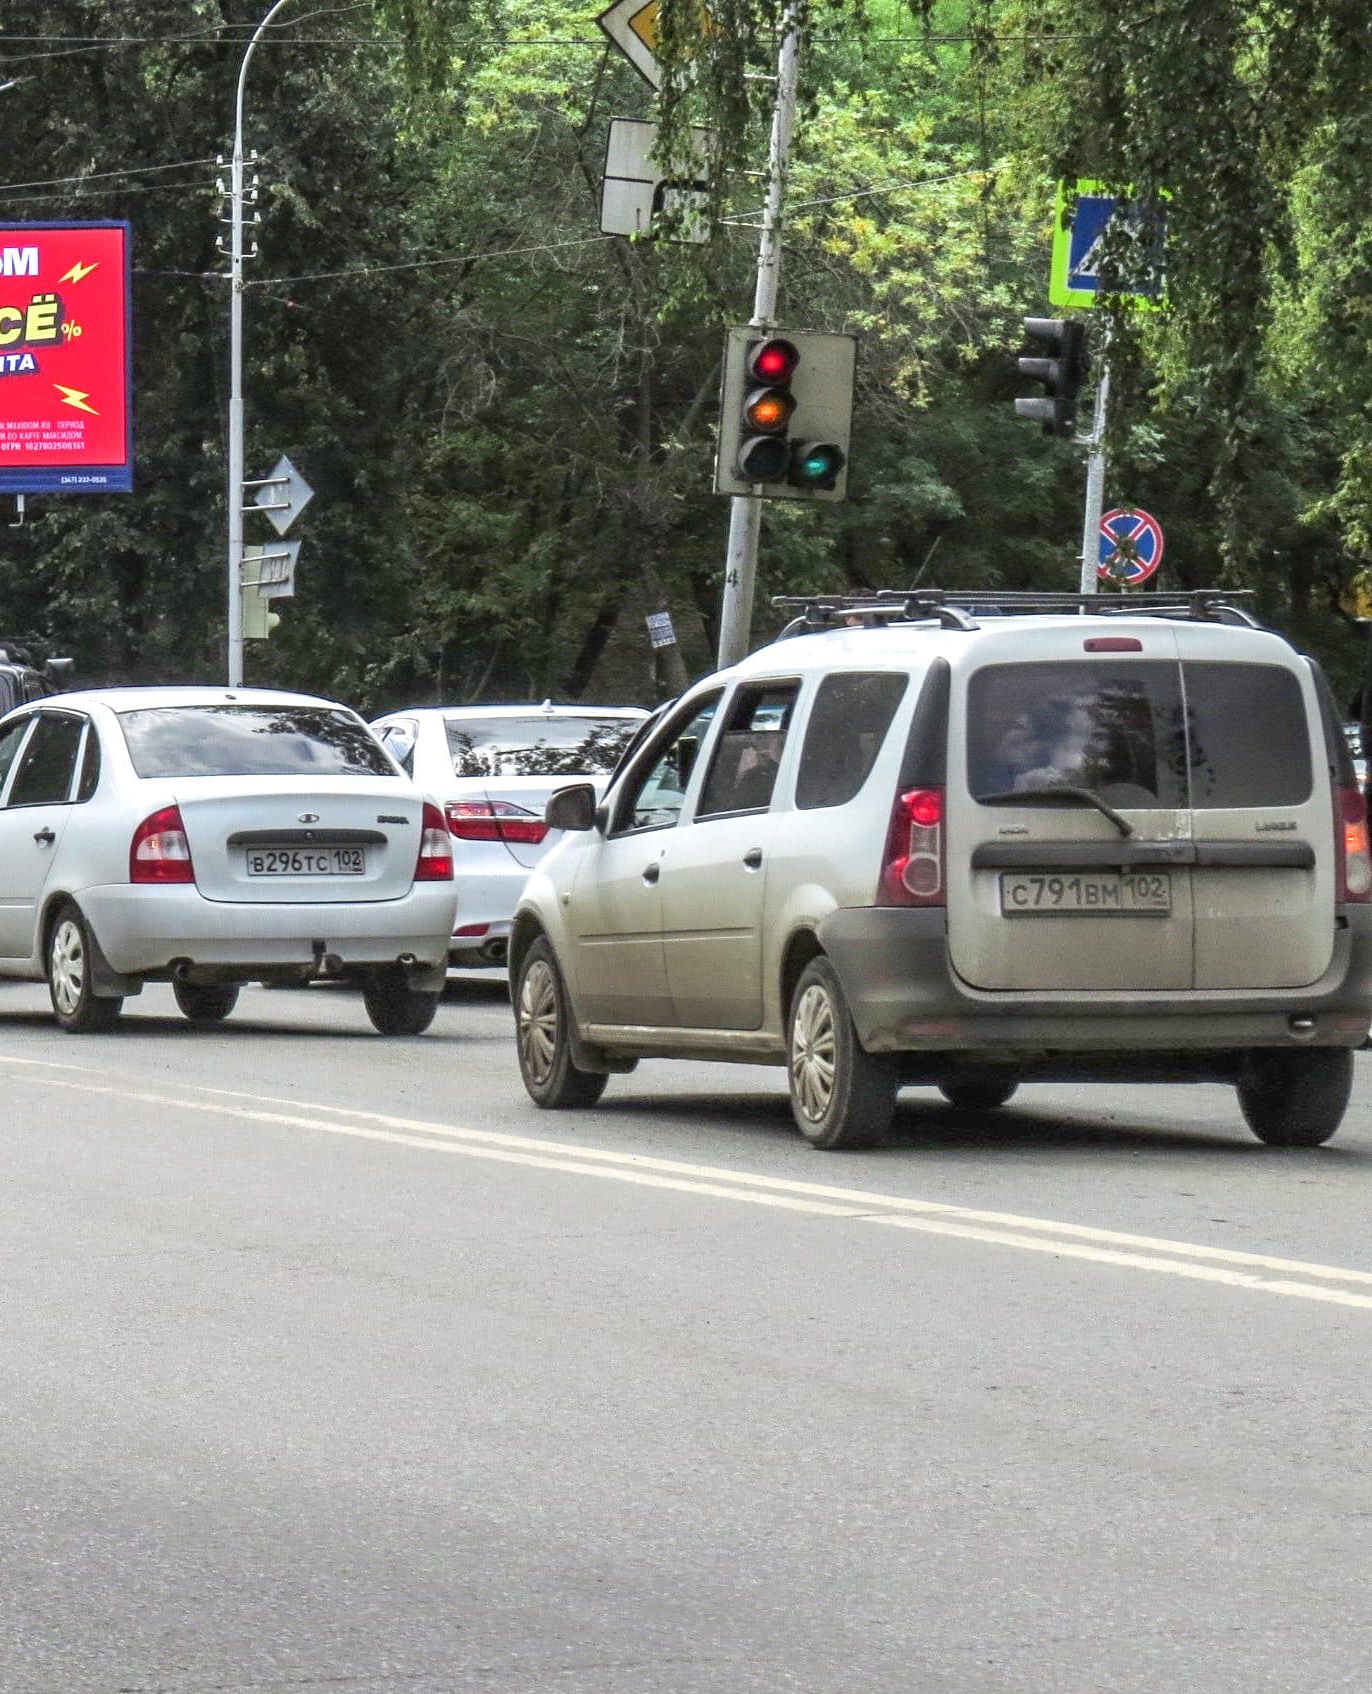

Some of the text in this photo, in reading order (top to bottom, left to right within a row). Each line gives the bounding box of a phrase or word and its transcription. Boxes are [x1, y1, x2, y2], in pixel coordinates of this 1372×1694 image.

[253, 850, 362, 873] В296ТС 102
[1011, 876, 1164, 906] С791ВМ 102
